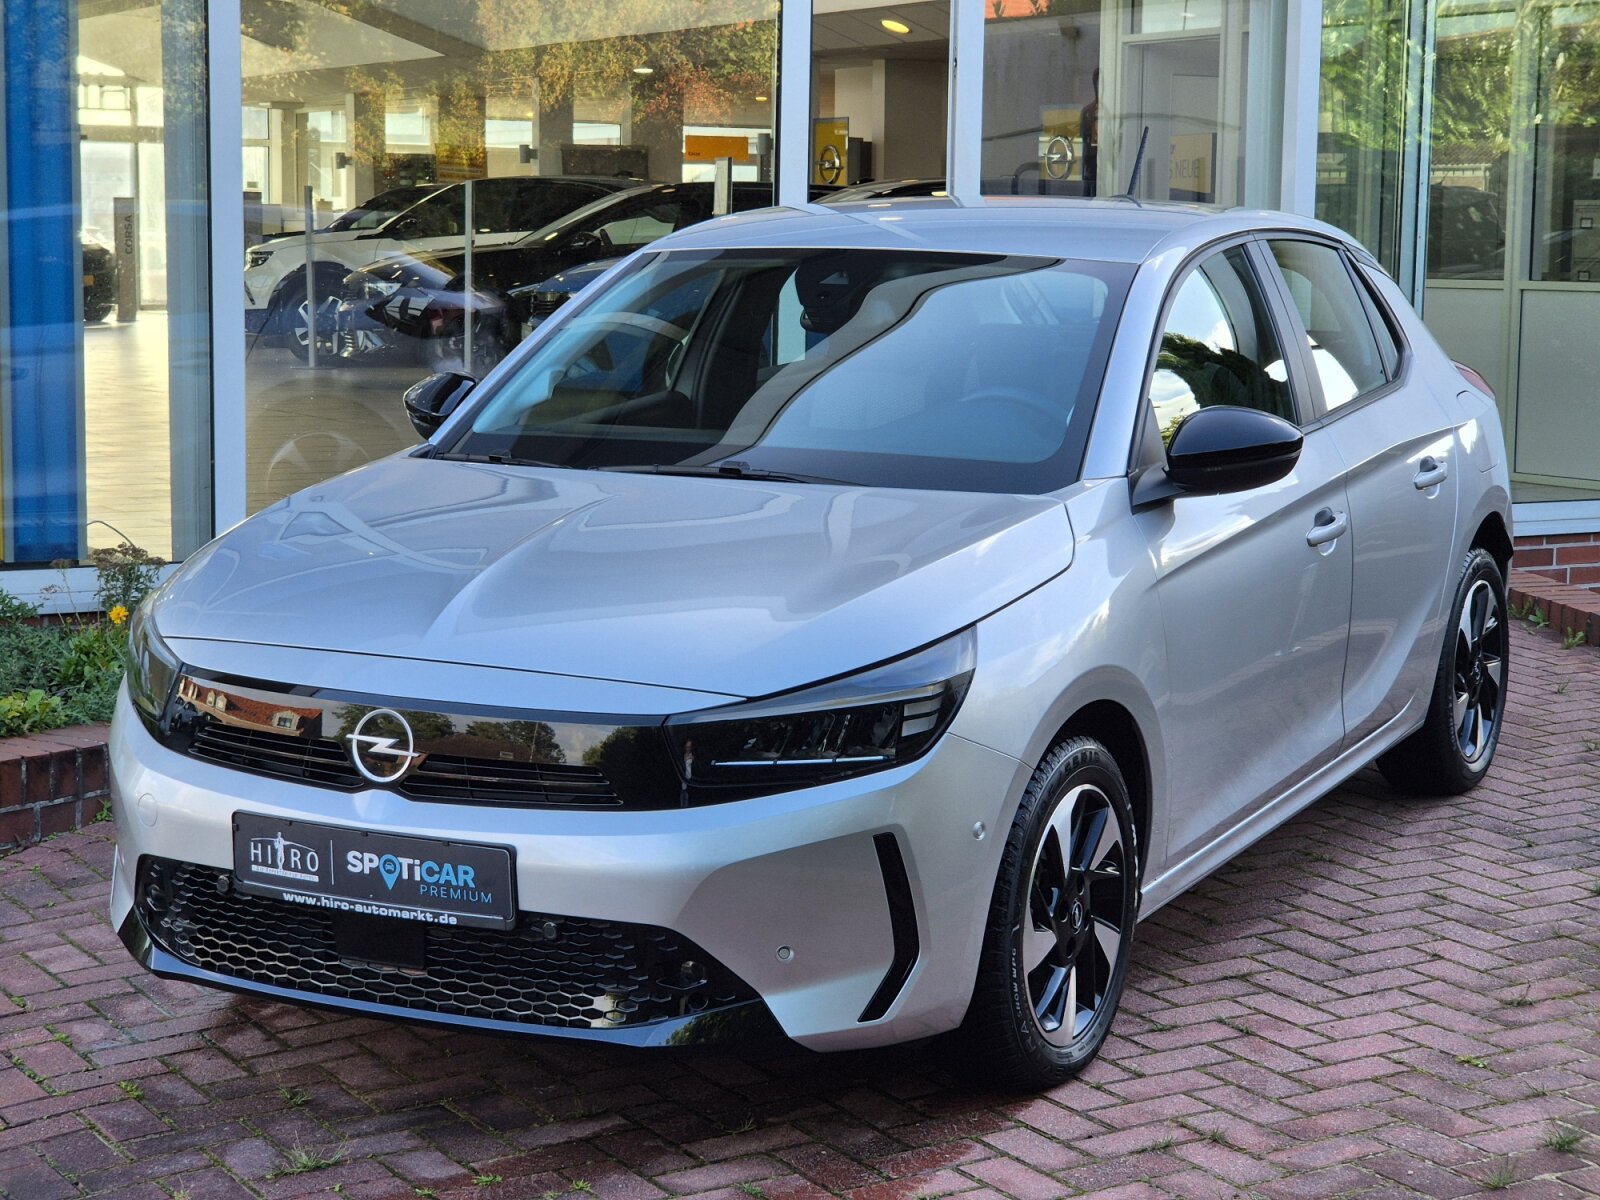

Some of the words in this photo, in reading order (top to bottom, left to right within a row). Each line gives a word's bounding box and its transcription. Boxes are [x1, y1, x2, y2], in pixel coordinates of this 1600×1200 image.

[124, 214, 133, 255] CORSA
[250, 841, 319, 872] HIRO
[282, 892, 458, 926] www.hiro-automarkt.de
[420, 884, 492, 903] PREMIUM
